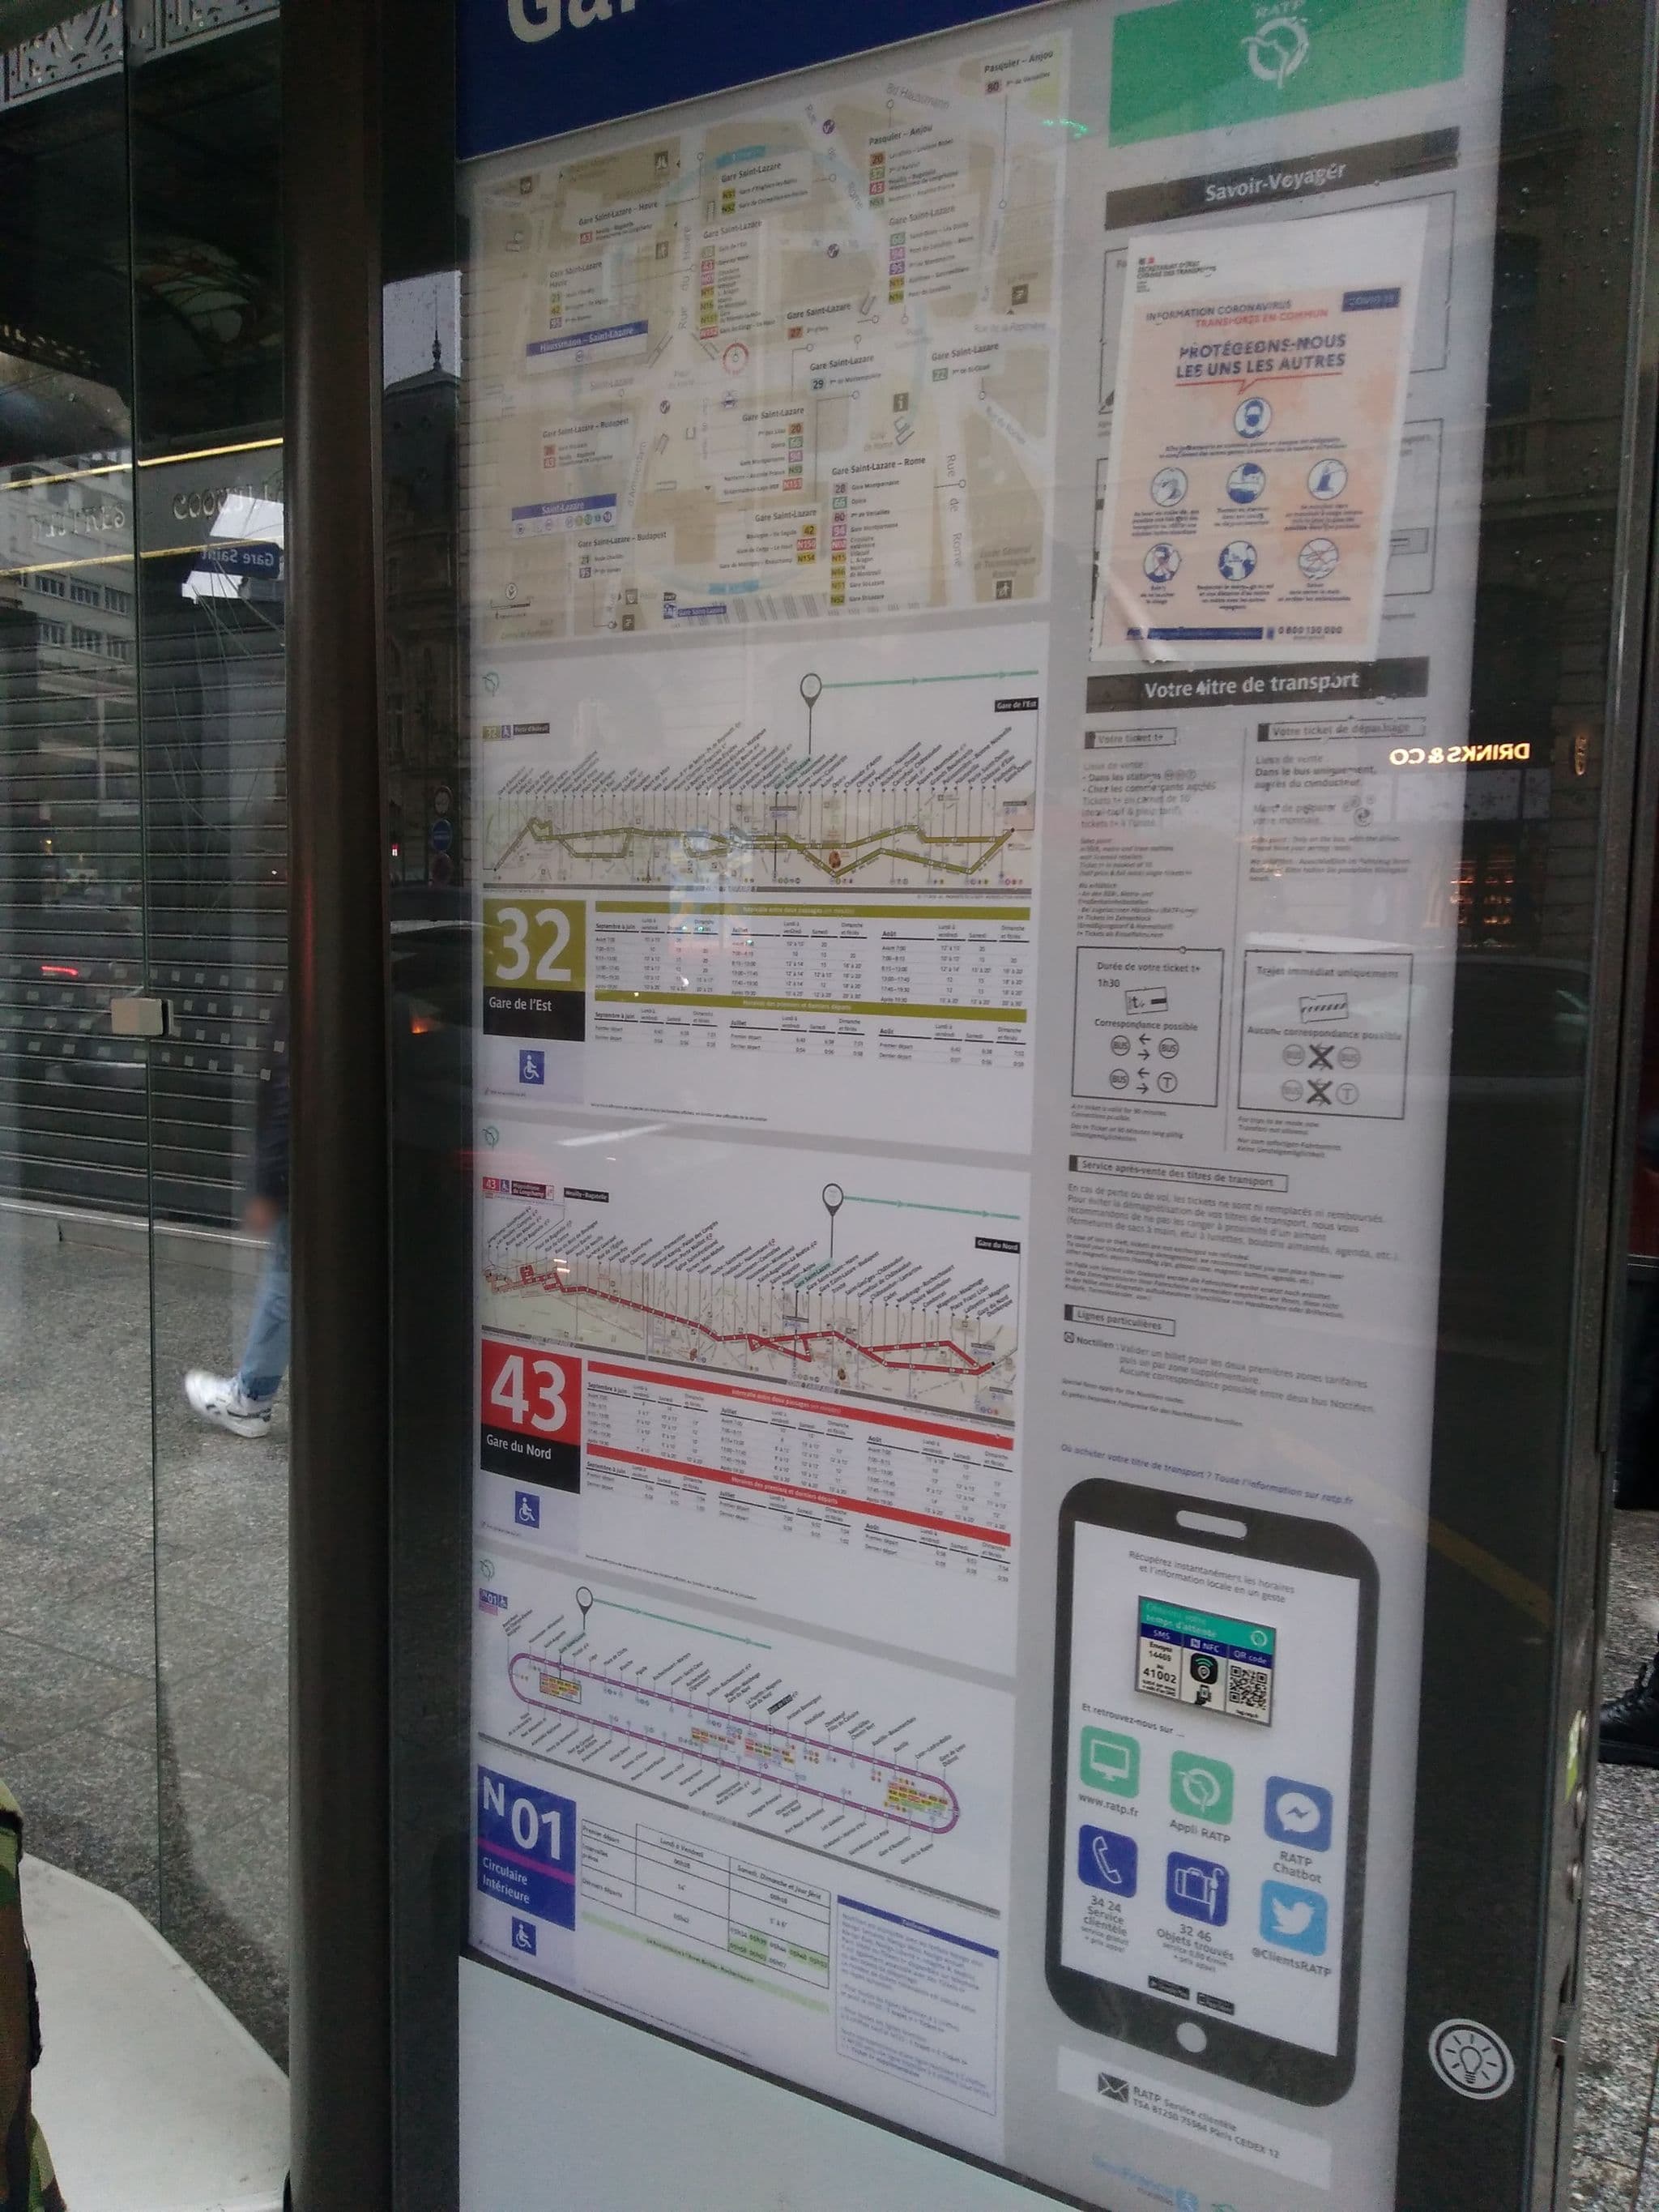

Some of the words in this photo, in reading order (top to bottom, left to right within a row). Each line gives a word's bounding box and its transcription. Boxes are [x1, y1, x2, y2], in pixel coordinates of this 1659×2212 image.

[507, 0, 636, 43] Ga
[1030, 50, 1056, 65] Anjou
[1204, 162, 1346, 203] Savoir-Voyager
[1208, 361, 1241, 376] UNS
[1247, 358, 1273, 372] LES
[1280, 353, 1346, 370] AUTRES
[812, 377, 825, 389] 29
[851, 461, 896, 475] Saint-Lazare
[904, 456, 926, 467] Rome
[1143, 682, 1192, 698] Votre
[1241, 676, 1265, 694] de
[1270, 672, 1360, 693] transport
[495, 907, 572, 982] 32
[1097, 961, 1122, 971] Durée
[1125, 962, 1135, 971] de
[1138, 963, 1160, 972] votre
[1097, 978, 1120, 988] 1h30
[488, 996, 512, 1010] Gare
[514, 997, 527, 1010] de
[529, 999, 552, 1012] l'Est
[1114, 1041, 1128, 1051] BUS
[1162, 1043, 1177, 1053] BUS
[1112, 1074, 1127, 1084] BUS
[1163, 1077, 1172, 1088] T
[1081, 1160, 1113, 1172] Service
[1115, 1164, 1167, 1177] après-vente
[1169, 1167, 1183, 1177] des
[1187, 1168, 1212, 1181] titres
[1213, 1172, 1226, 1182] de
[1229, 1173, 1274, 1187] transport
[1077, 1309, 1105, 1323] Lignes
[490, 1354, 568, 1433] 43
[486, 1434, 510, 1450] Gare
[510, 1440, 523, 1454] du
[526, 1445, 552, 1460] Nord
[1153, 1629, 1171, 1640] SMS
[1202, 1642, 1219, 1653] NFC
[1234, 1650, 1247, 1659] QR
[1248, 1655, 1268, 1664] code
[1142, 1668, 1177, 1685] 41002
[1081, 1702, 1092, 1713] Et
[1094, 1706, 1158, 1732] retrouvez-nous
[1160, 1724, 1174, 1735] sur
[1078, 1792, 1140, 1818] www.ratp.fr
[483, 1775, 505, 1817] N
[510, 1797, 561, 1861] 01
[1169, 1818, 1198, 1836] Appli
[1201, 1827, 1231, 1844] RATP
[1279, 1850, 1313, 1867] RATP
[482, 1856, 528, 1886] Circulaire
[1272, 1861, 1322, 1885] Chatbot
[482, 1873, 531, 1905] Intérieure
[1090, 1894, 1104, 1907] 34
[1107, 1899, 1122, 1913] 24
[1087, 1904, 1124, 1925] Service
[1083, 1915, 1128, 1937] clientèle
[1179, 1923, 1193, 1937] 32
[1196, 1929, 1212, 1942] 46
[1156, 1928, 1192, 1946] Objets
[1194, 1937, 1235, 1961] trouvés
[1251, 1946, 1333, 1977] @ClientsRATP
[1133, 2085, 1162, 2102] RATP
[1234, 2135, 1265, 2154] CEDEX
